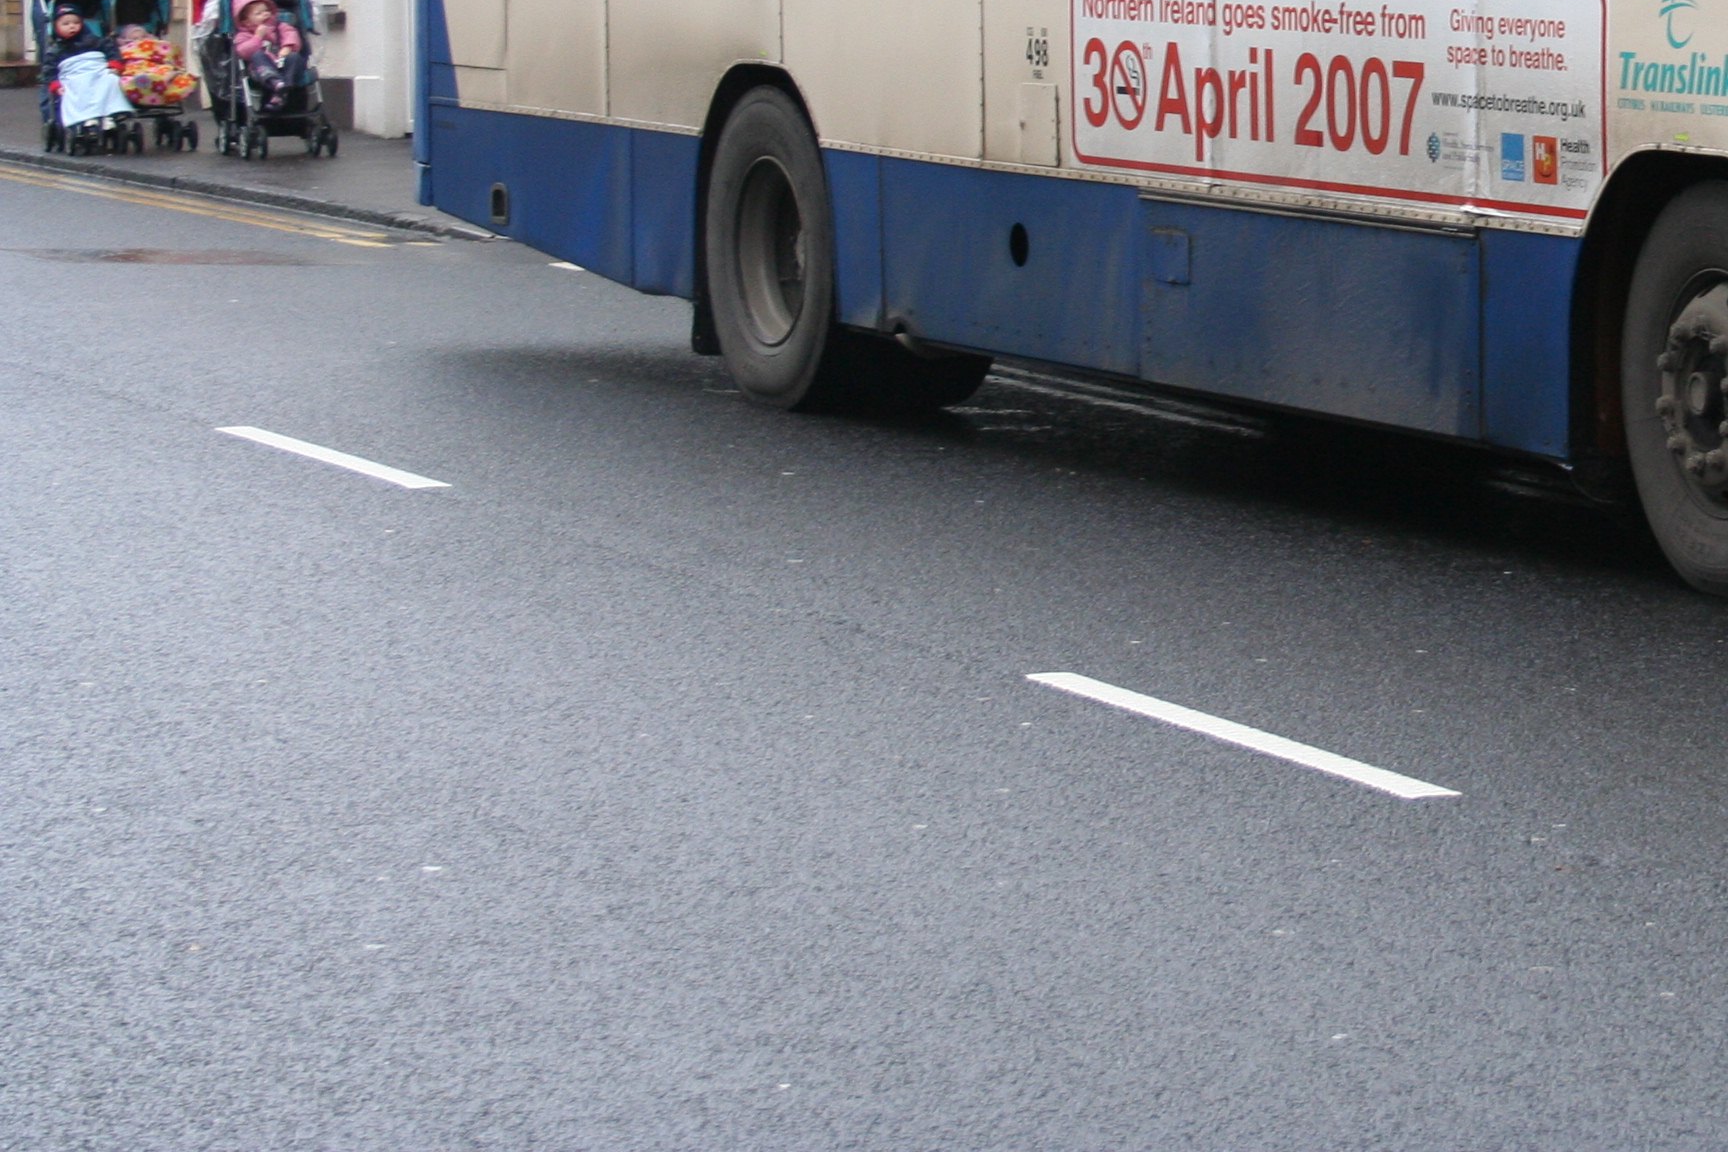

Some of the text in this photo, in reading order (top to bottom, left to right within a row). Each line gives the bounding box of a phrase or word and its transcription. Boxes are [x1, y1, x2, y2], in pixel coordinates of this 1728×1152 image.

[1222, 2, 1265, 36] goes
[1271, 1, 1375, 36] smoke-free
[1380, 4, 1426, 39] from
[1450, 9, 1565, 42] Giving everyone
[1447, 45, 1567, 71] space to breathe.
[1155, 42, 1274, 162] April
[1294, 52, 1425, 156] 2007
[1431, 92, 1586, 121] www.spacetobreathe.org.uk
